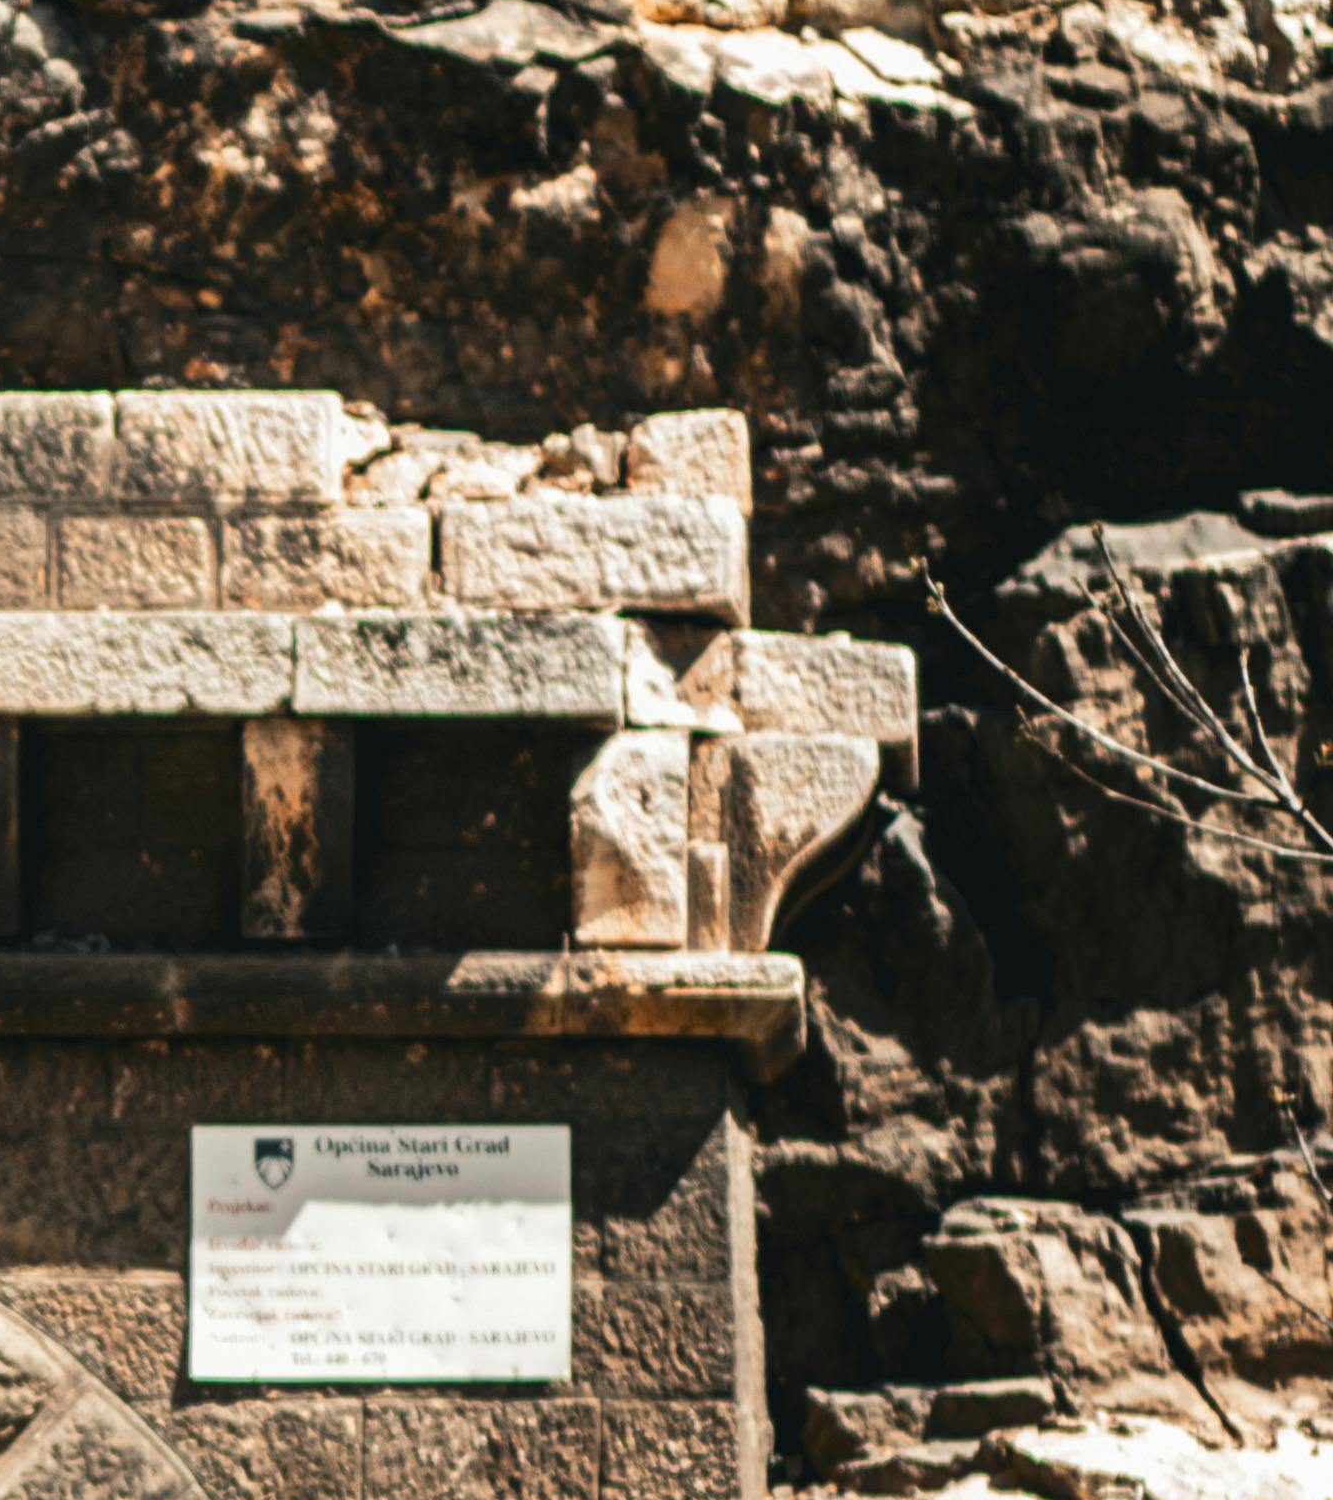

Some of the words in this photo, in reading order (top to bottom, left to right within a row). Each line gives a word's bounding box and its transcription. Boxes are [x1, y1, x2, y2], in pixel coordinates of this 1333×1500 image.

[314, 1135, 391, 1159] Općina
[398, 1135, 449, 1154] Stari
[454, 1135, 511, 1155] Grad
[365, 1158, 460, 1179] Sarajevo
[356, 1262, 404, 1276] STARI
[408, 1262, 457, 1276] GRAD
[469, 1262, 556, 1276] SARAJEVO
[356, 1331, 404, 1346] STARI
[408, 1331, 457, 1346] GRAD
[469, 1331, 556, 1346] SARAJEVO
